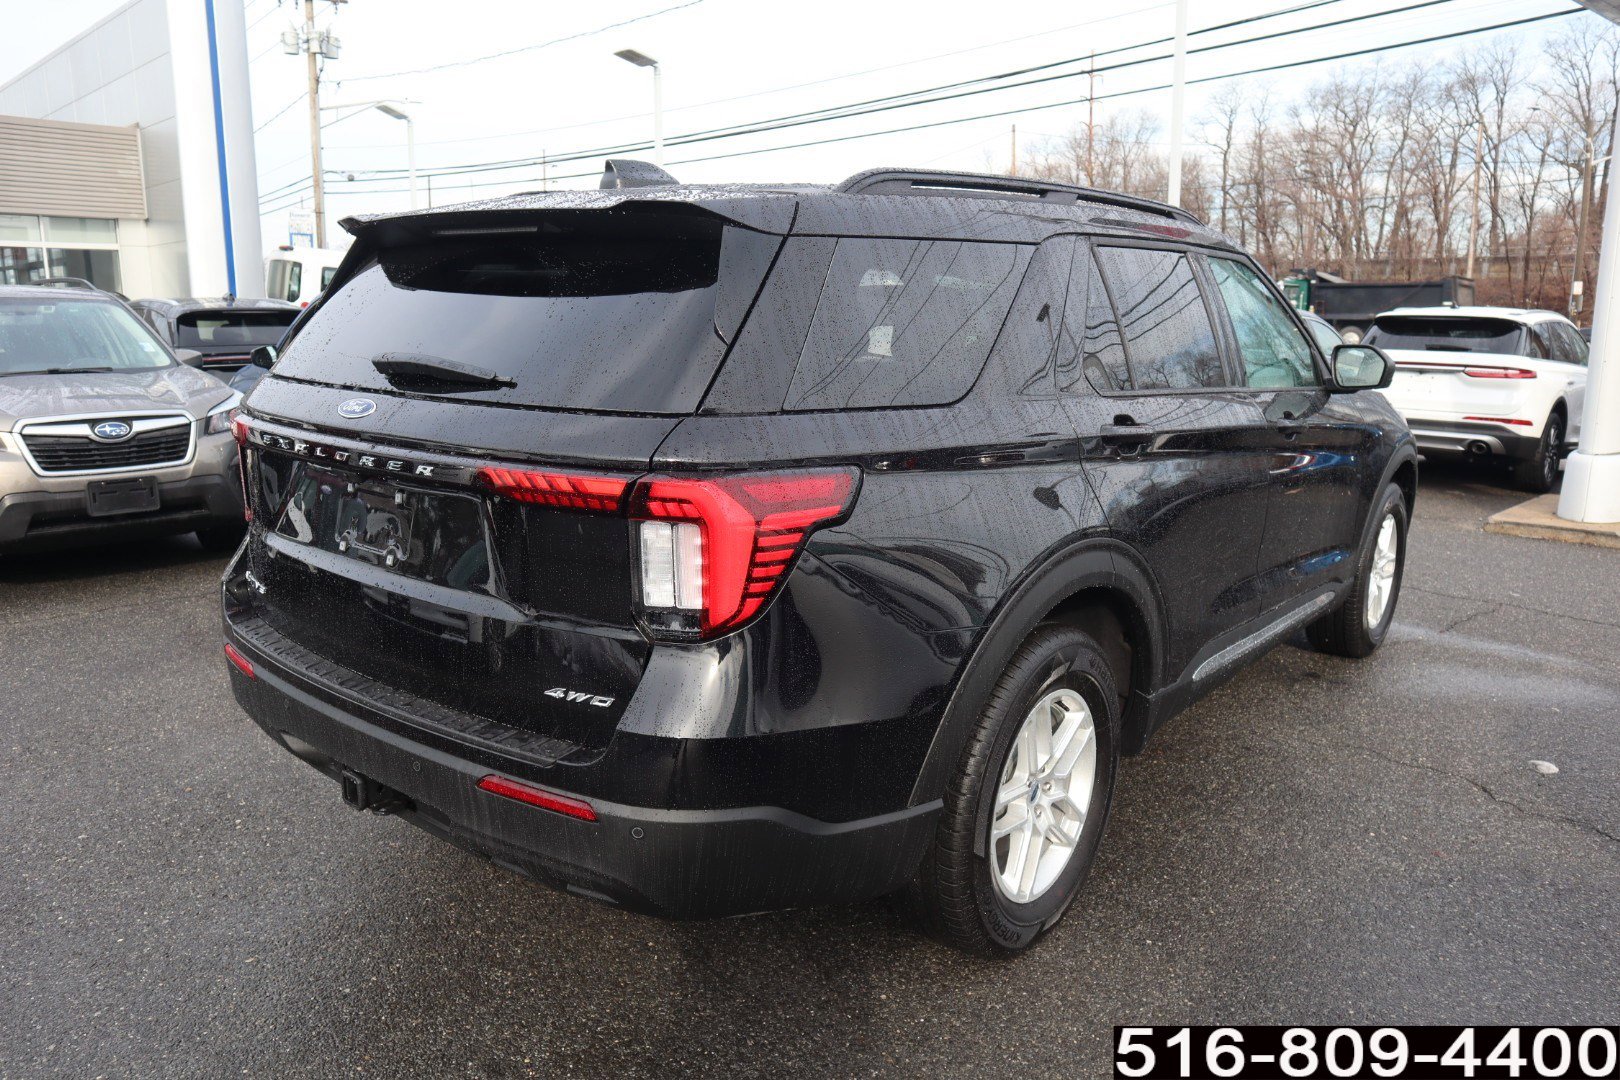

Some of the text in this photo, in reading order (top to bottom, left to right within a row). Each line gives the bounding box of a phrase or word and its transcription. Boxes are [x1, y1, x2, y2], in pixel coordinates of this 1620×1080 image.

[340, 400, 372, 414] Ford
[263, 434, 434, 477] EXPLORER
[543, 687, 616, 708] 4WD
